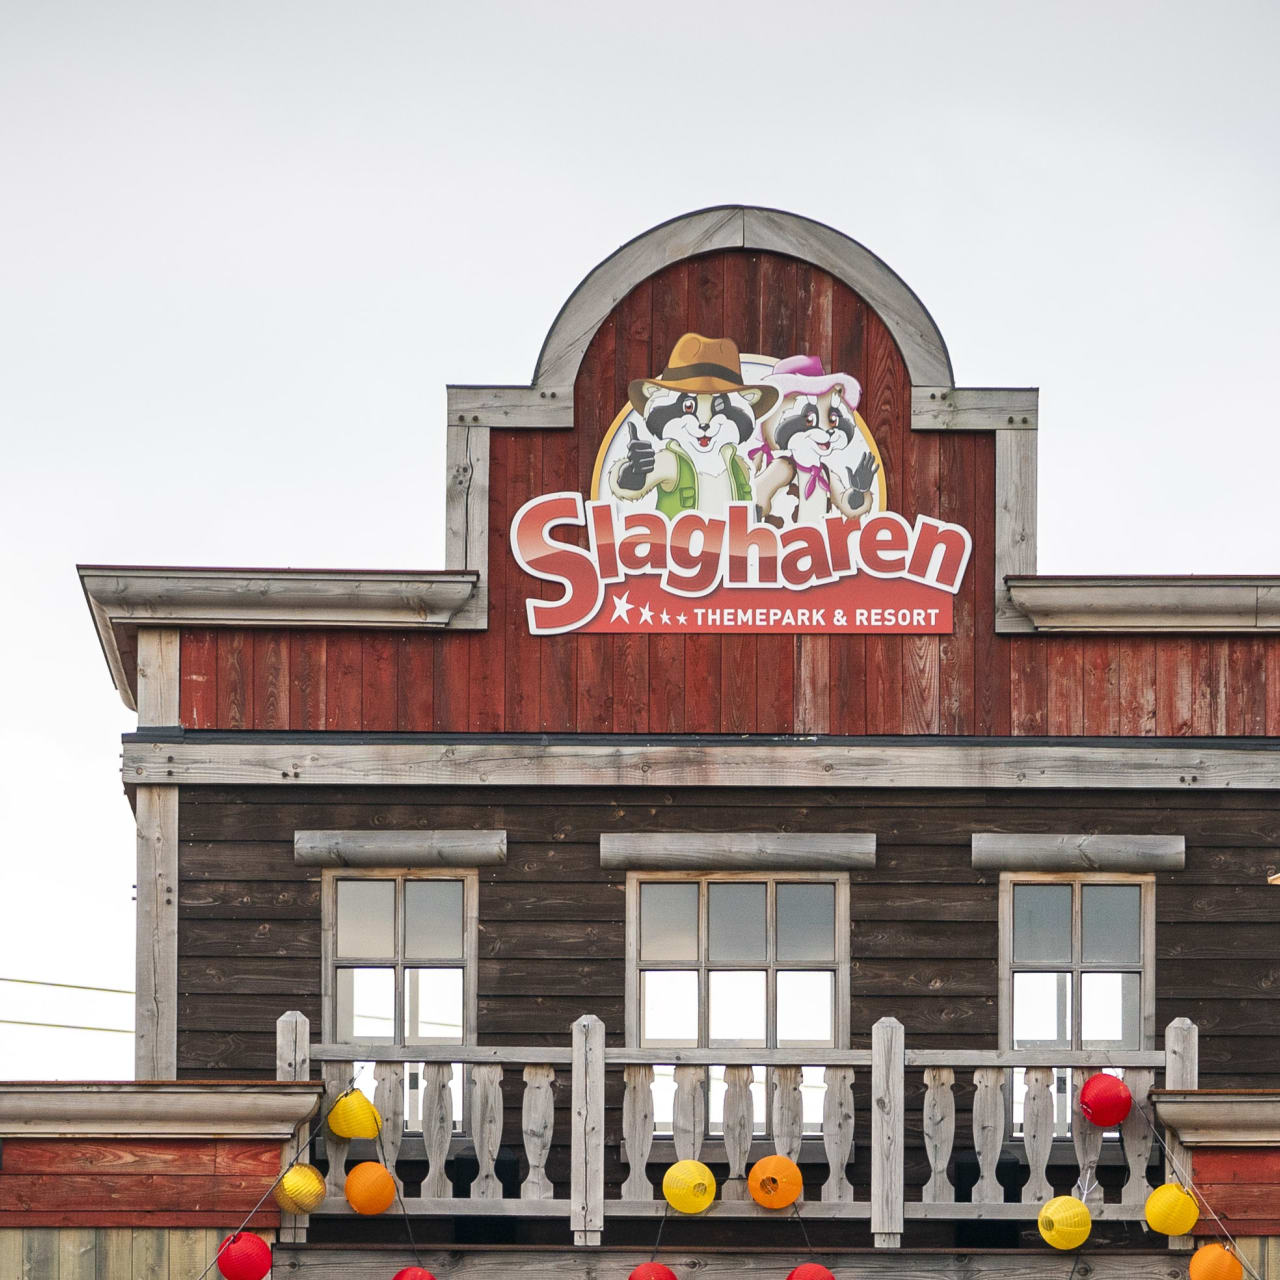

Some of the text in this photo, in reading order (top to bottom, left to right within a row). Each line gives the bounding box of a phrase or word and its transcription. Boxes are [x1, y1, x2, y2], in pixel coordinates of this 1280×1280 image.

[511, 492, 972, 635] Slagharen
[693, 608, 940, 627] THEMEPARK & RESORT
